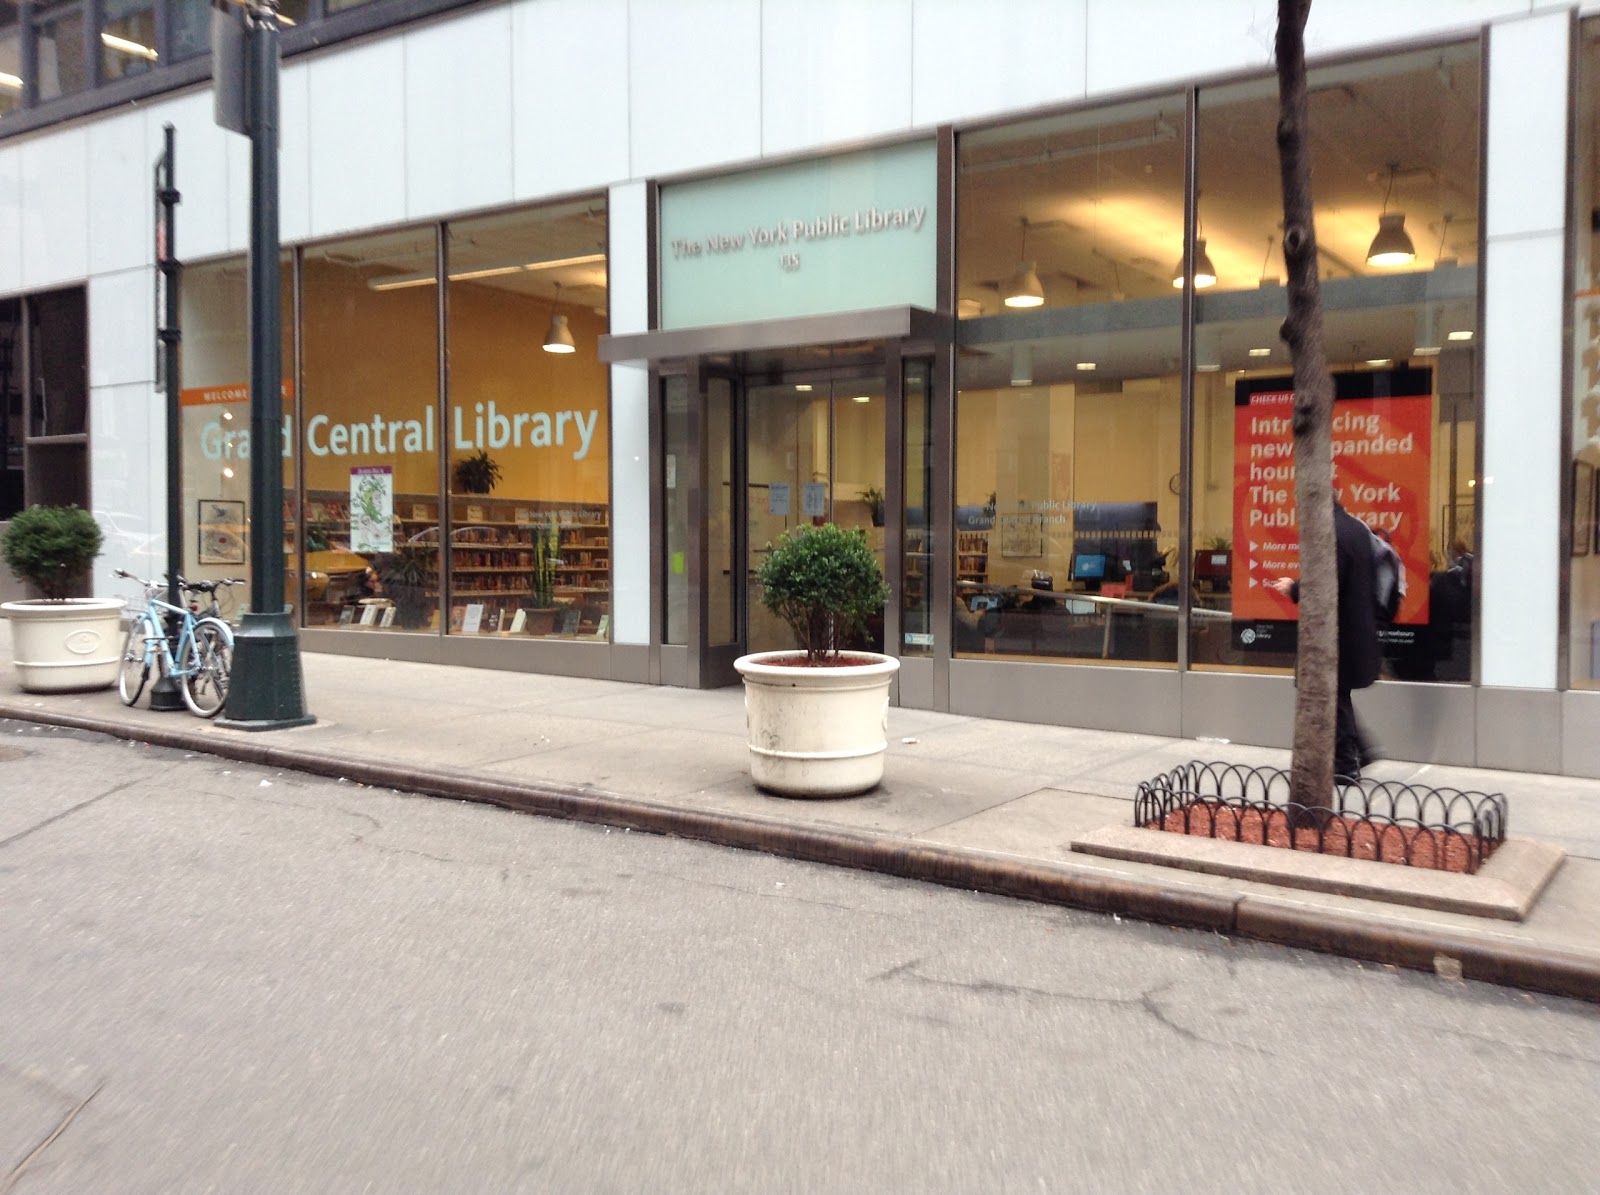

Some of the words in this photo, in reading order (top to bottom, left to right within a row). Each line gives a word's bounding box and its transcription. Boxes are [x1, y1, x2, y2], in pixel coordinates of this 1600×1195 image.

[671, 237, 702, 259] The
[706, 233, 744, 254] New
[748, 224, 789, 247] York
[792, 212, 850, 240] Public
[854, 204, 926, 234] Library
[203, 389, 248, 401] WELCOME
[1251, 395, 1275, 405] CHECK
[201, 414, 292, 461] Grad
[307, 405, 434, 457] Central
[453, 401, 598, 460] Library
[1251, 410, 1381, 437] Intrcing
[1250, 441, 1294, 458] new
[1329, 432, 1414, 461] panded
[1249, 485, 1288, 504] The
[1350, 481, 1401, 504] York
[1062, 499, 1097, 512] Library
[968, 514, 996, 525] Grand
[1249, 508, 1296, 528] Publ
[1262, 541, 1287, 551] More
[1262, 560, 1287, 570] More
